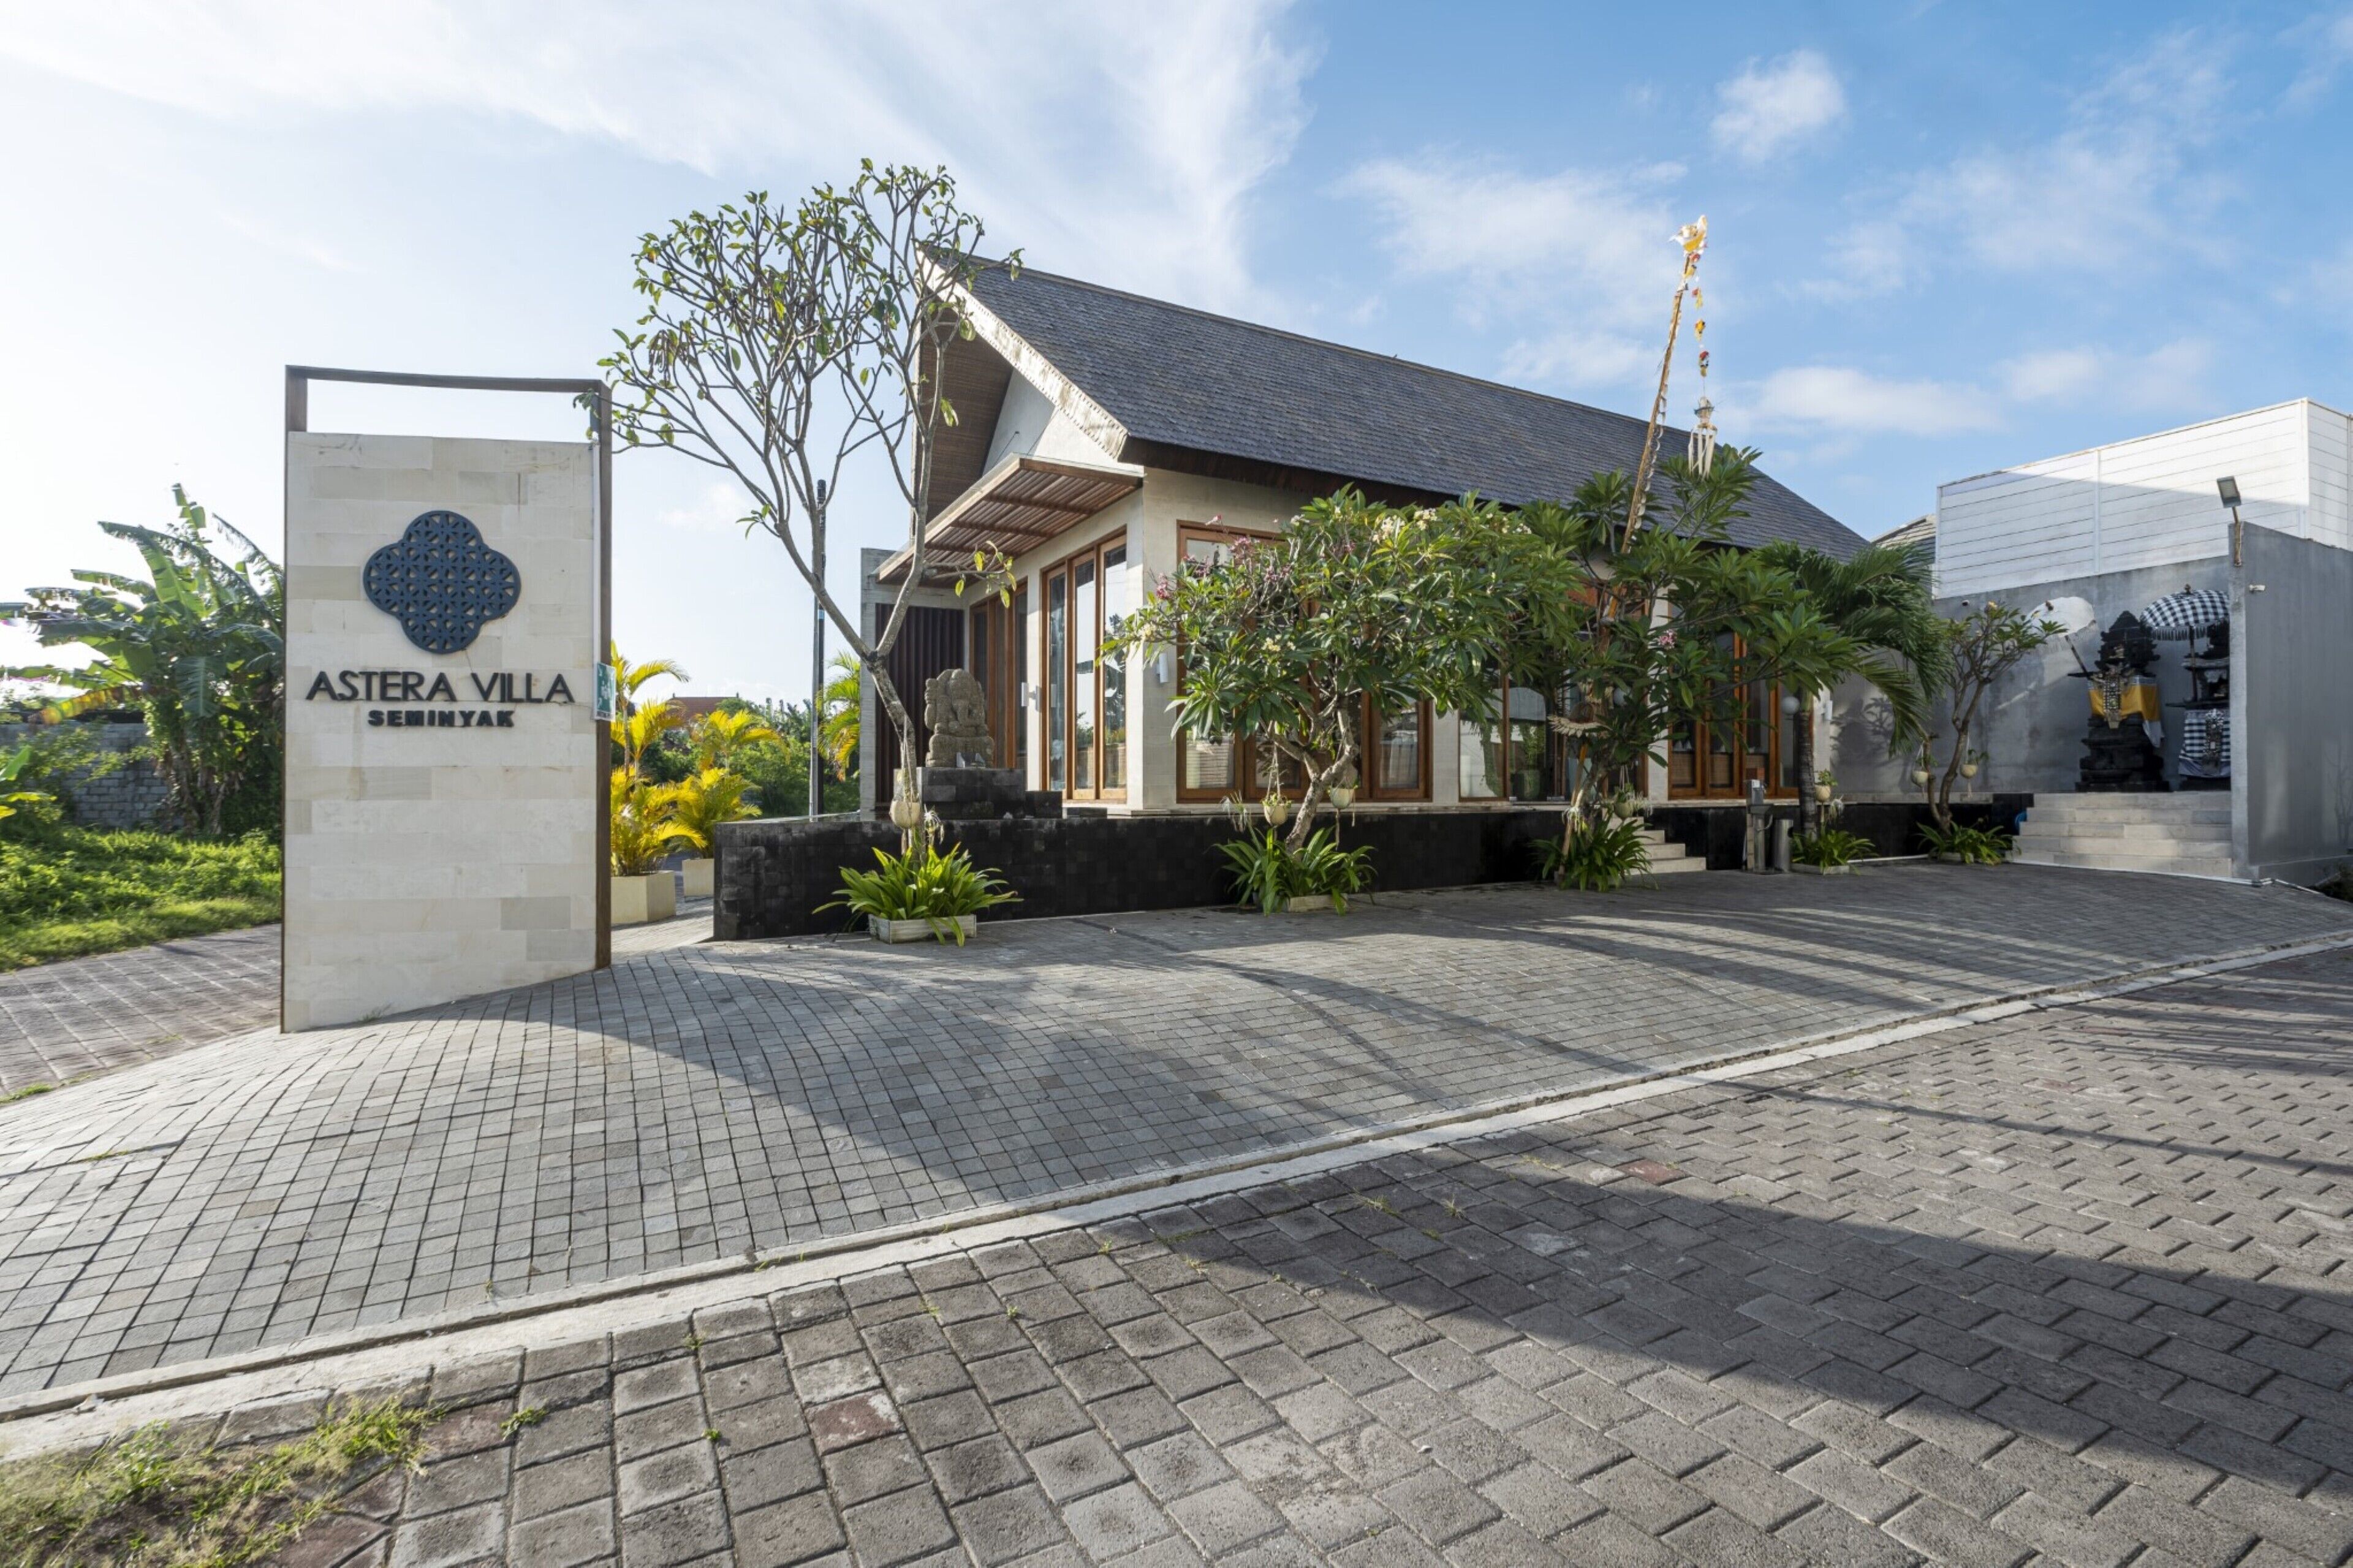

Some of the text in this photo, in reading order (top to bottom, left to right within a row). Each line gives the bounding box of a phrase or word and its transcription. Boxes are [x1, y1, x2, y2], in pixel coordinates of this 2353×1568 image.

[306, 671, 575, 703] ASTERA VILLA
[368, 710, 515, 727] SEMINYAK
